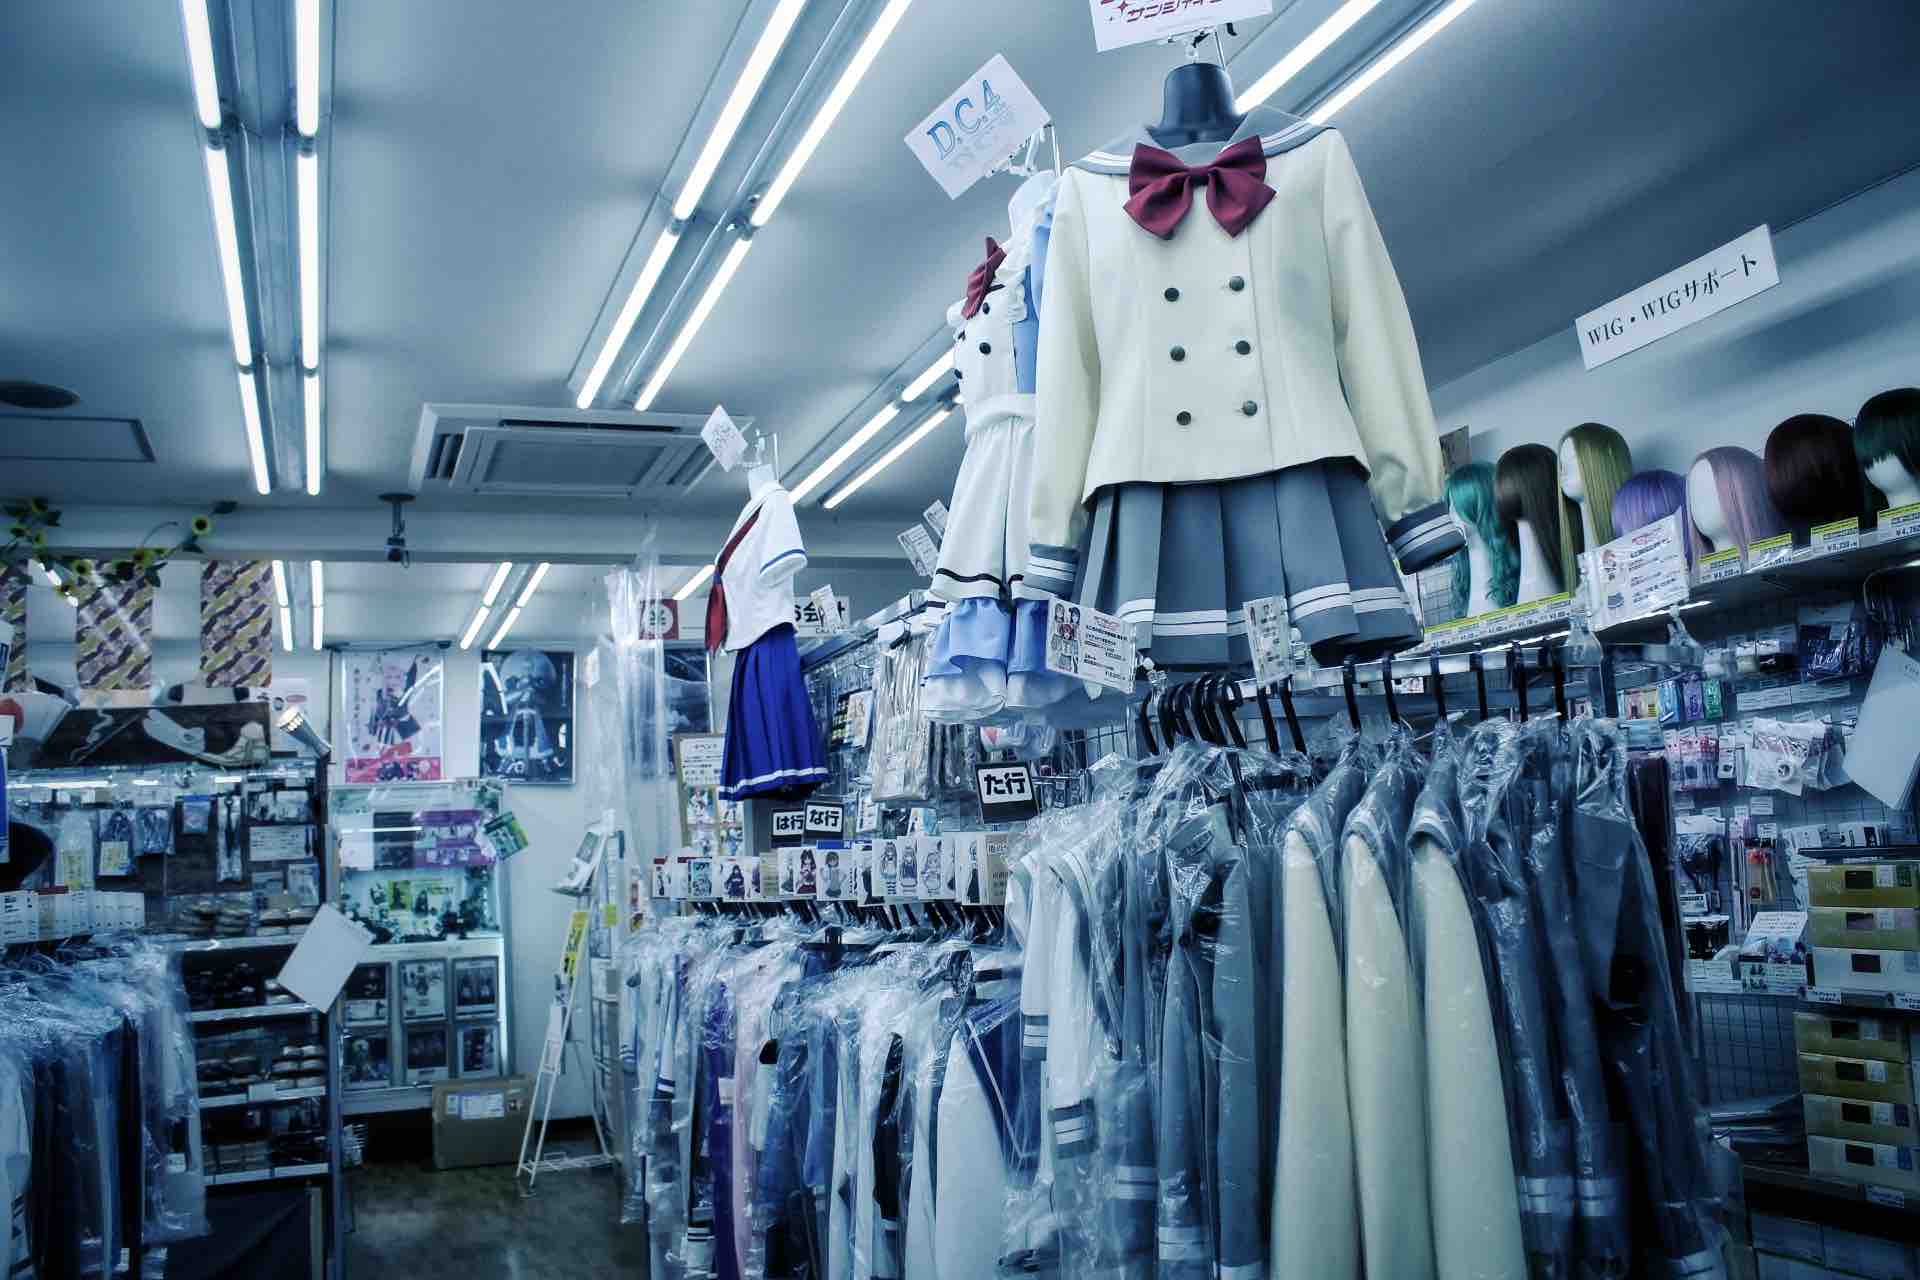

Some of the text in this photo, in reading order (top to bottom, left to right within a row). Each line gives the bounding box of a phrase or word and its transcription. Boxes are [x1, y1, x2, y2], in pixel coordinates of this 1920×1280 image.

[983, 771, 1026, 796] た行
[775, 814, 804, 831] は行
[808, 809, 840, 828] な行
